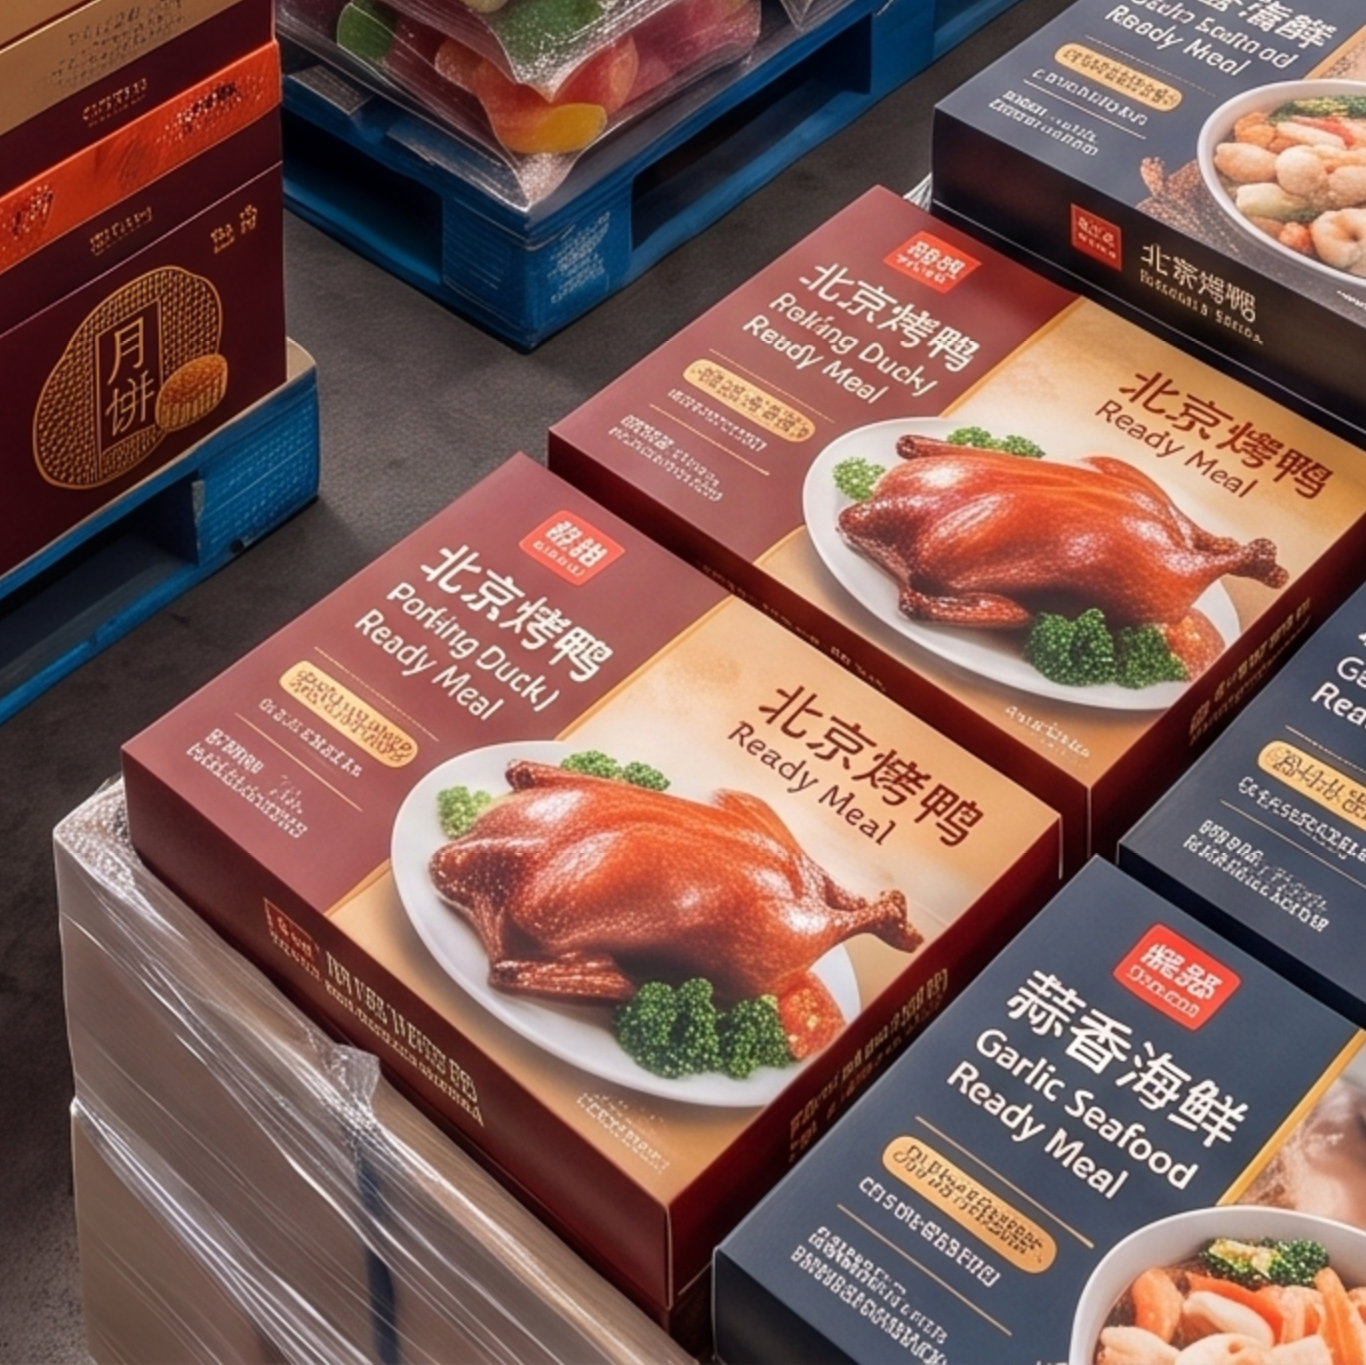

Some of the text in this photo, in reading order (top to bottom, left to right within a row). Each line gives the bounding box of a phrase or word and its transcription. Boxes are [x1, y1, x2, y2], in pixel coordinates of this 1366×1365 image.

[822, 361, 888, 403] Meal
[1095, 400, 1258, 497] Ready Meal
[355, 609, 504, 720] Ready Meal
[728, 721, 896, 845] Ready Meal
[948, 1061, 1128, 1198] Ready Meal
[977, 1030, 1198, 1189] Garlic Seafood
